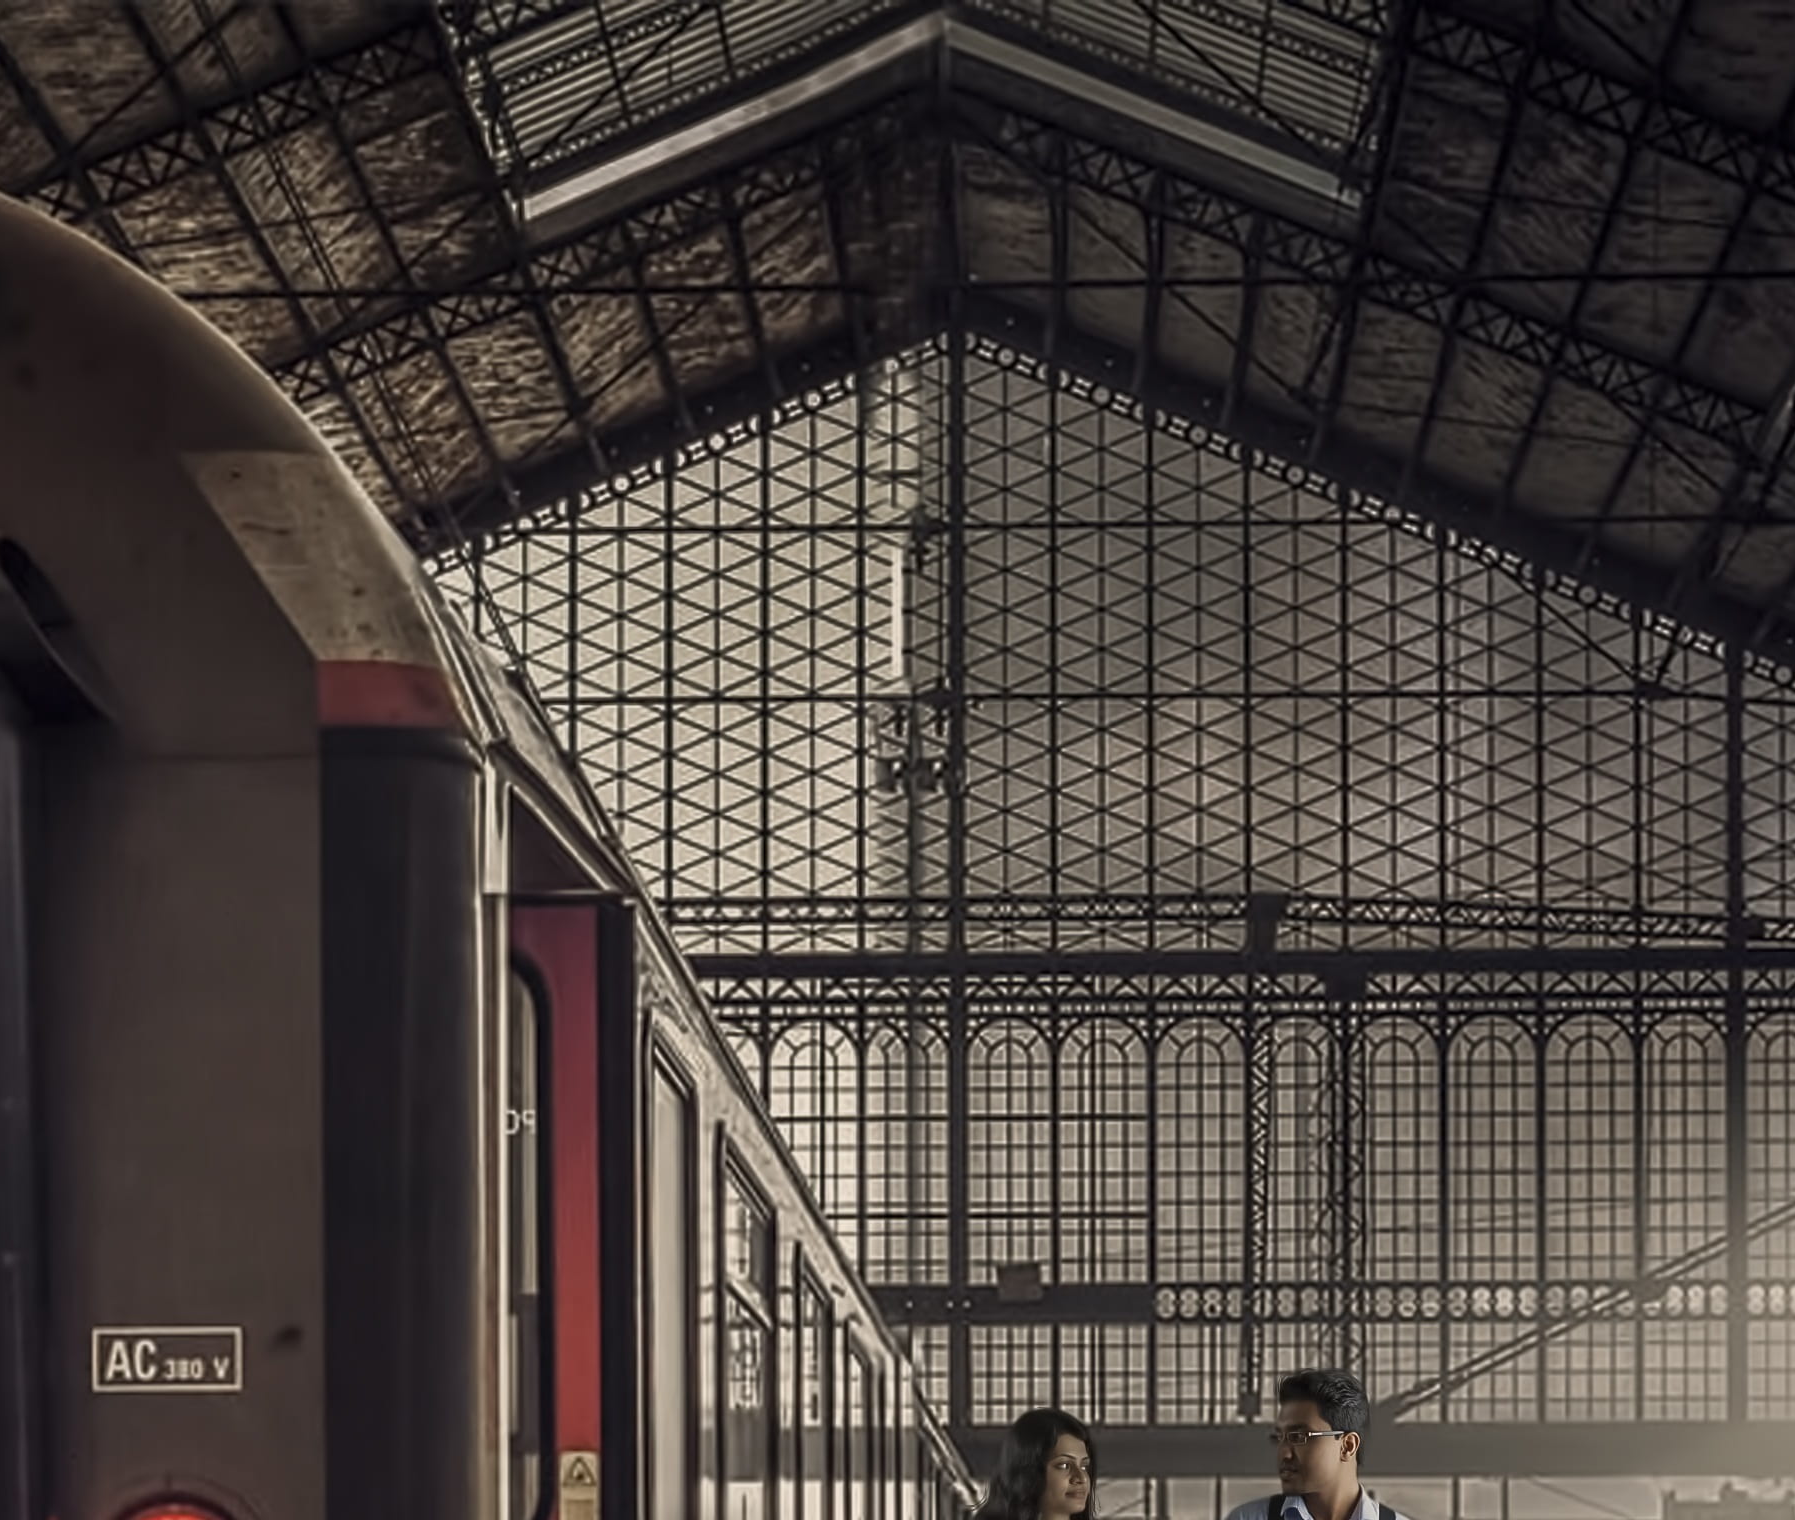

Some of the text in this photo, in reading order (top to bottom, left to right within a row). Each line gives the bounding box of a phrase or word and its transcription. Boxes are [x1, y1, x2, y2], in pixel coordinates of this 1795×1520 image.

[106, 1339, 230, 1381] AC 380 V
